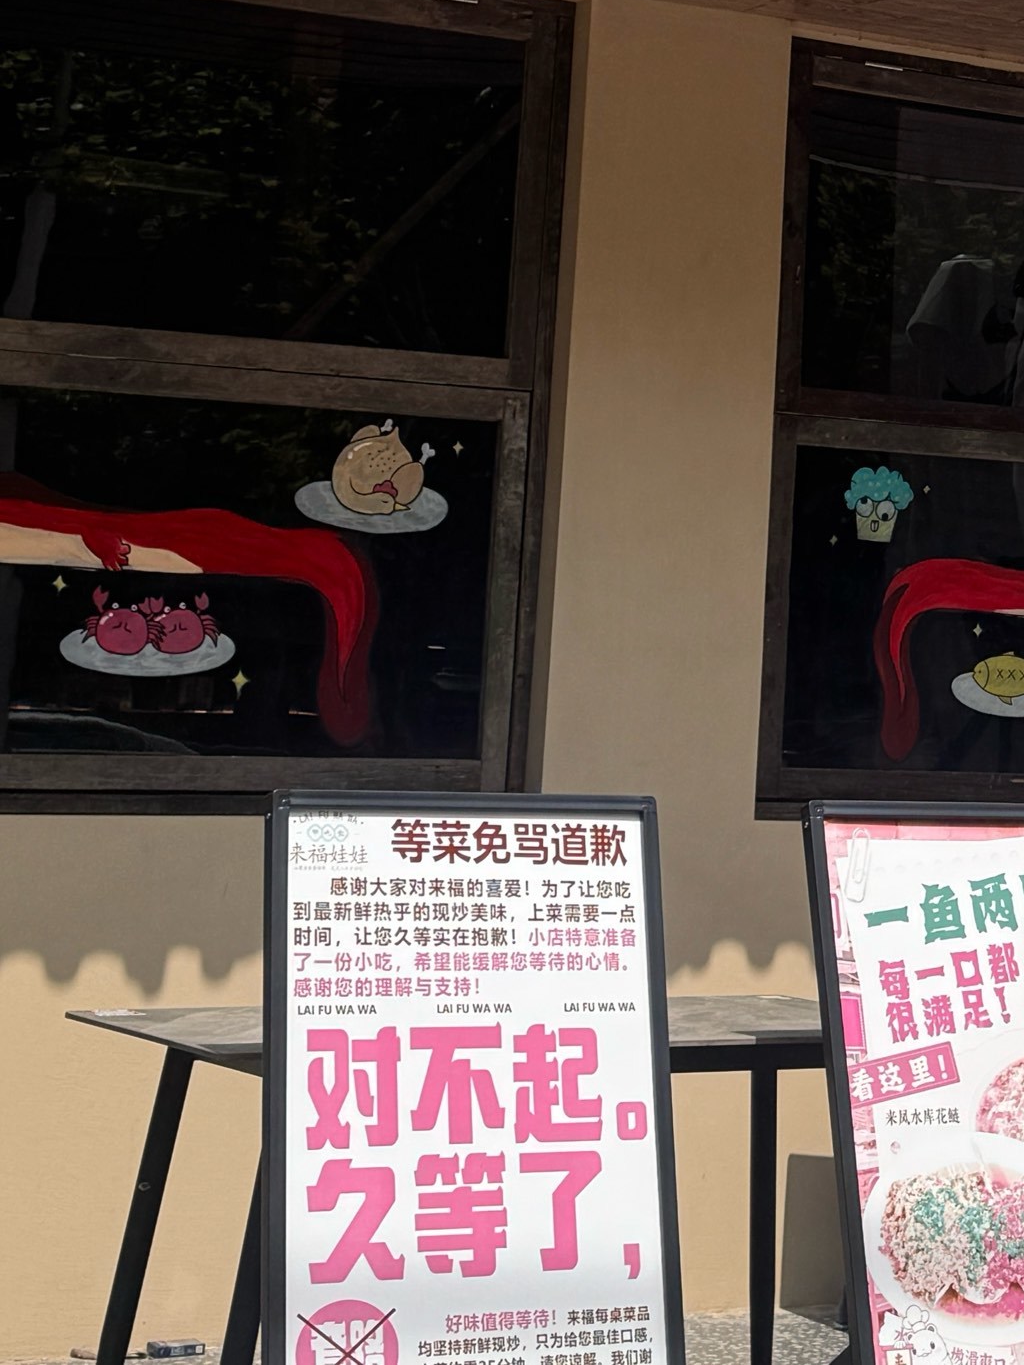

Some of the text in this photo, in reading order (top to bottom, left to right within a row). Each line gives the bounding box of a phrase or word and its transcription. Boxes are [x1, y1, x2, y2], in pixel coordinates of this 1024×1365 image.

[290, 842, 368, 864] 来福娃娃
[391, 819, 627, 866] 等菜免骂道歉
[293, 976, 480, 997] 感谢您的理解与支持！
[878, 942, 1020, 1000] 每一口都
[297, 1004, 377, 1015] LAI FU WA WA
[436, 1003, 512, 1014] LAI FU WA WA
[564, 1002, 636, 1012] LAI FU WA WA
[886, 987, 1014, 1044] 很满足！
[306, 1022, 648, 1150] 对不起。
[850, 1054, 948, 1101] 看这里！
[306, 1151, 641, 1284] 久等了，
